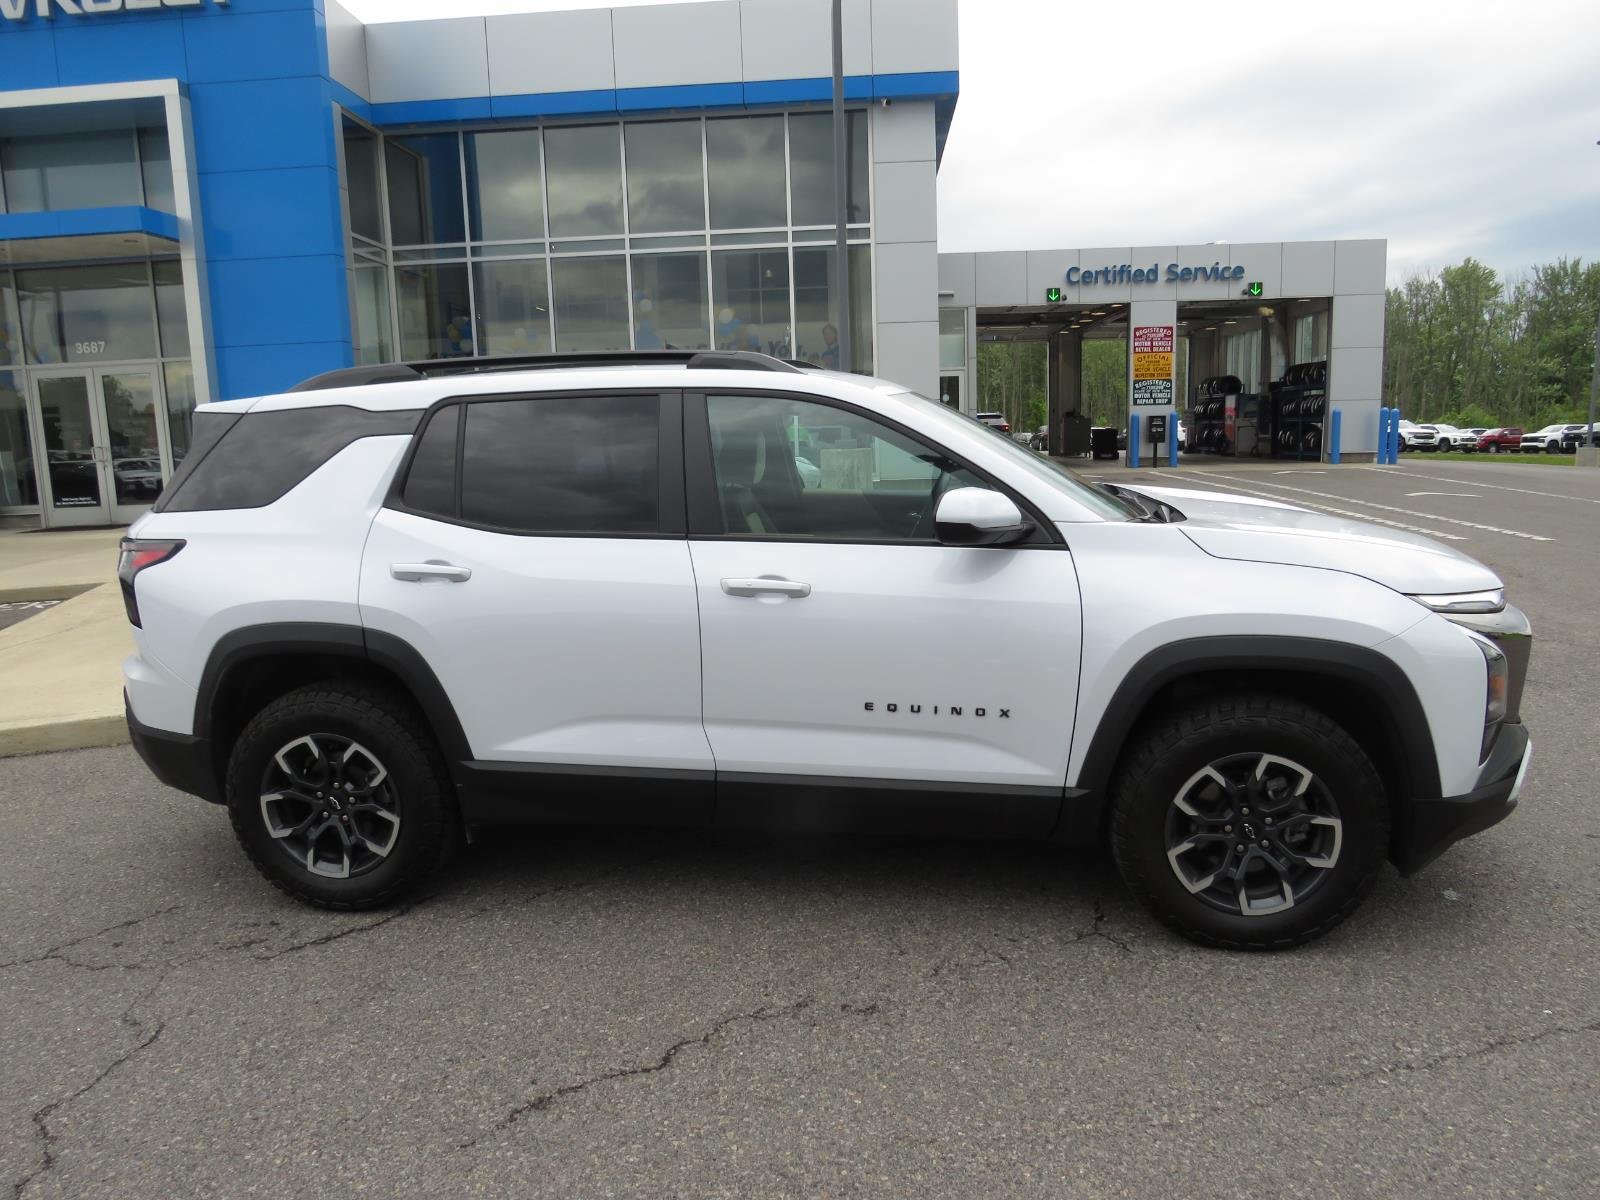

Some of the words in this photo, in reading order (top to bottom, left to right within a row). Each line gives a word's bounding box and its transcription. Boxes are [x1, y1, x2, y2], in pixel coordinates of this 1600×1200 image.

[1066, 263, 1159, 286] Certified
[1165, 262, 1245, 283] Service
[1136, 327, 1172, 337] REGISTERED
[75, 341, 105, 354] 3687
[1137, 354, 1169, 362] OFFICIAL
[1135, 380, 1171, 389] REGISTERED
[864, 702, 1010, 718] EQUINOX
